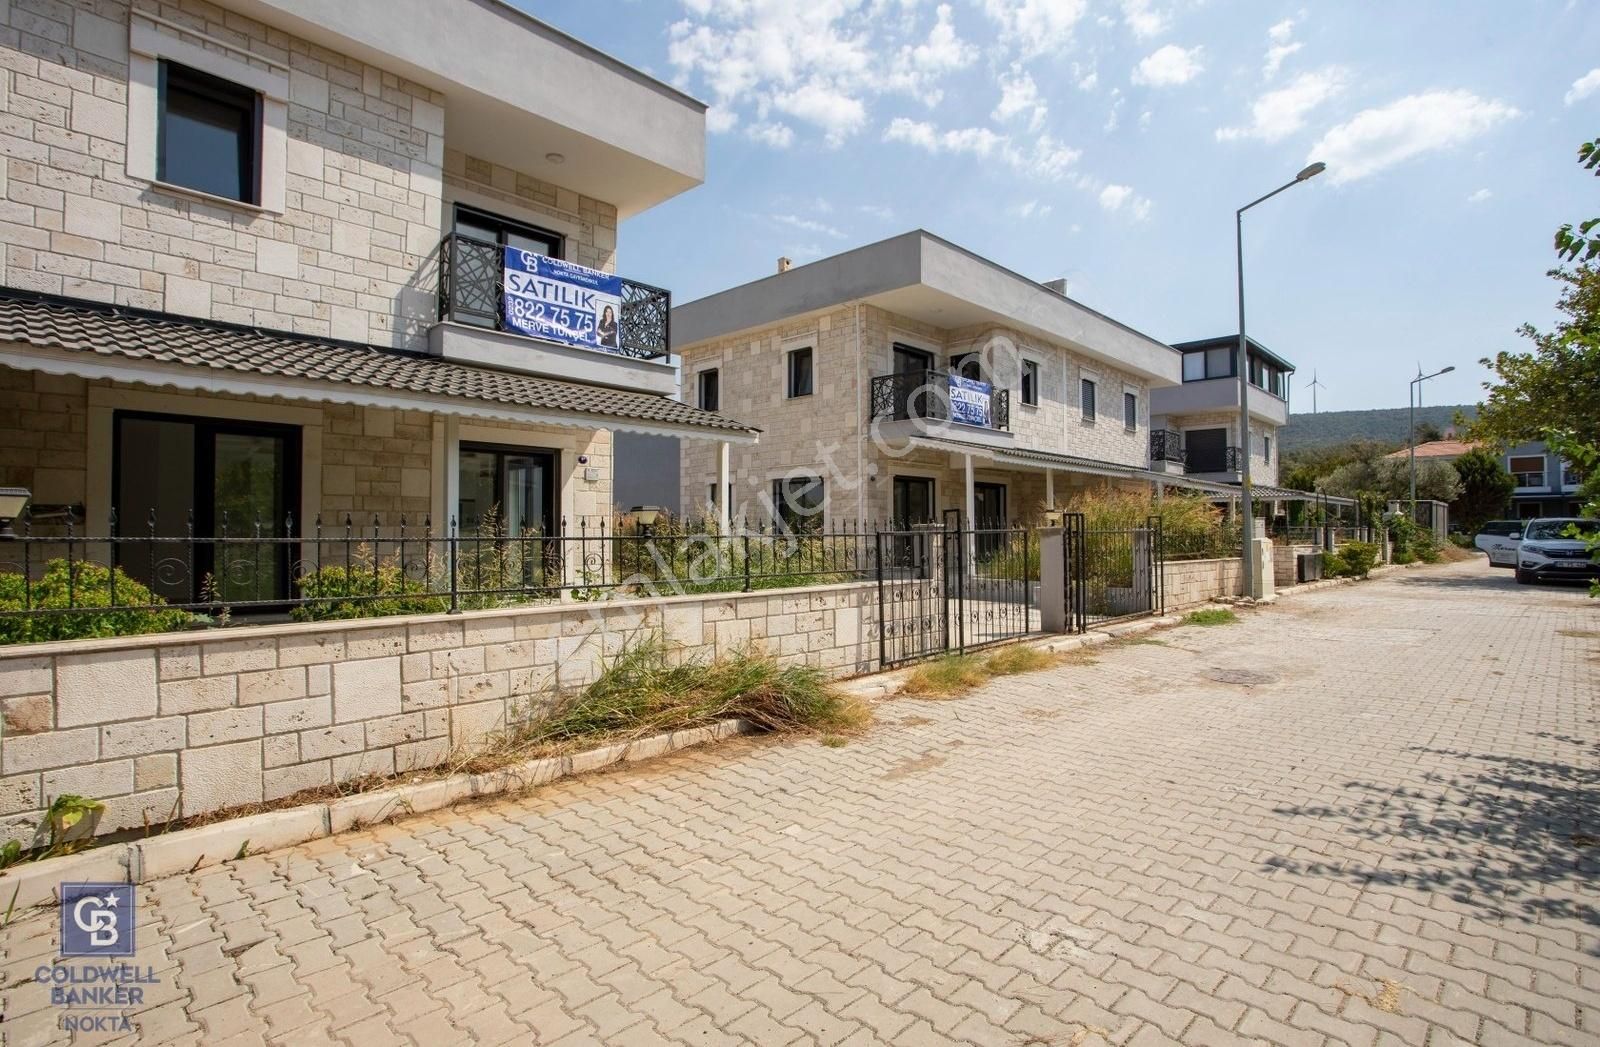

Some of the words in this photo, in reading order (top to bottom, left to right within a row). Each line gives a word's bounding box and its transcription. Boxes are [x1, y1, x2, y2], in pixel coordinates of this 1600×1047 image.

[542, 256, 581, 273] COLDWELL
[583, 266, 610, 280] BANKER
[508, 274, 595, 311] SATILIK
[512, 317, 549, 334] MERVE
[514, 298, 545, 322] 822
[551, 306, 570, 328] 75
[575, 312, 594, 333] 75
[951, 388, 983, 405] SATILIK
